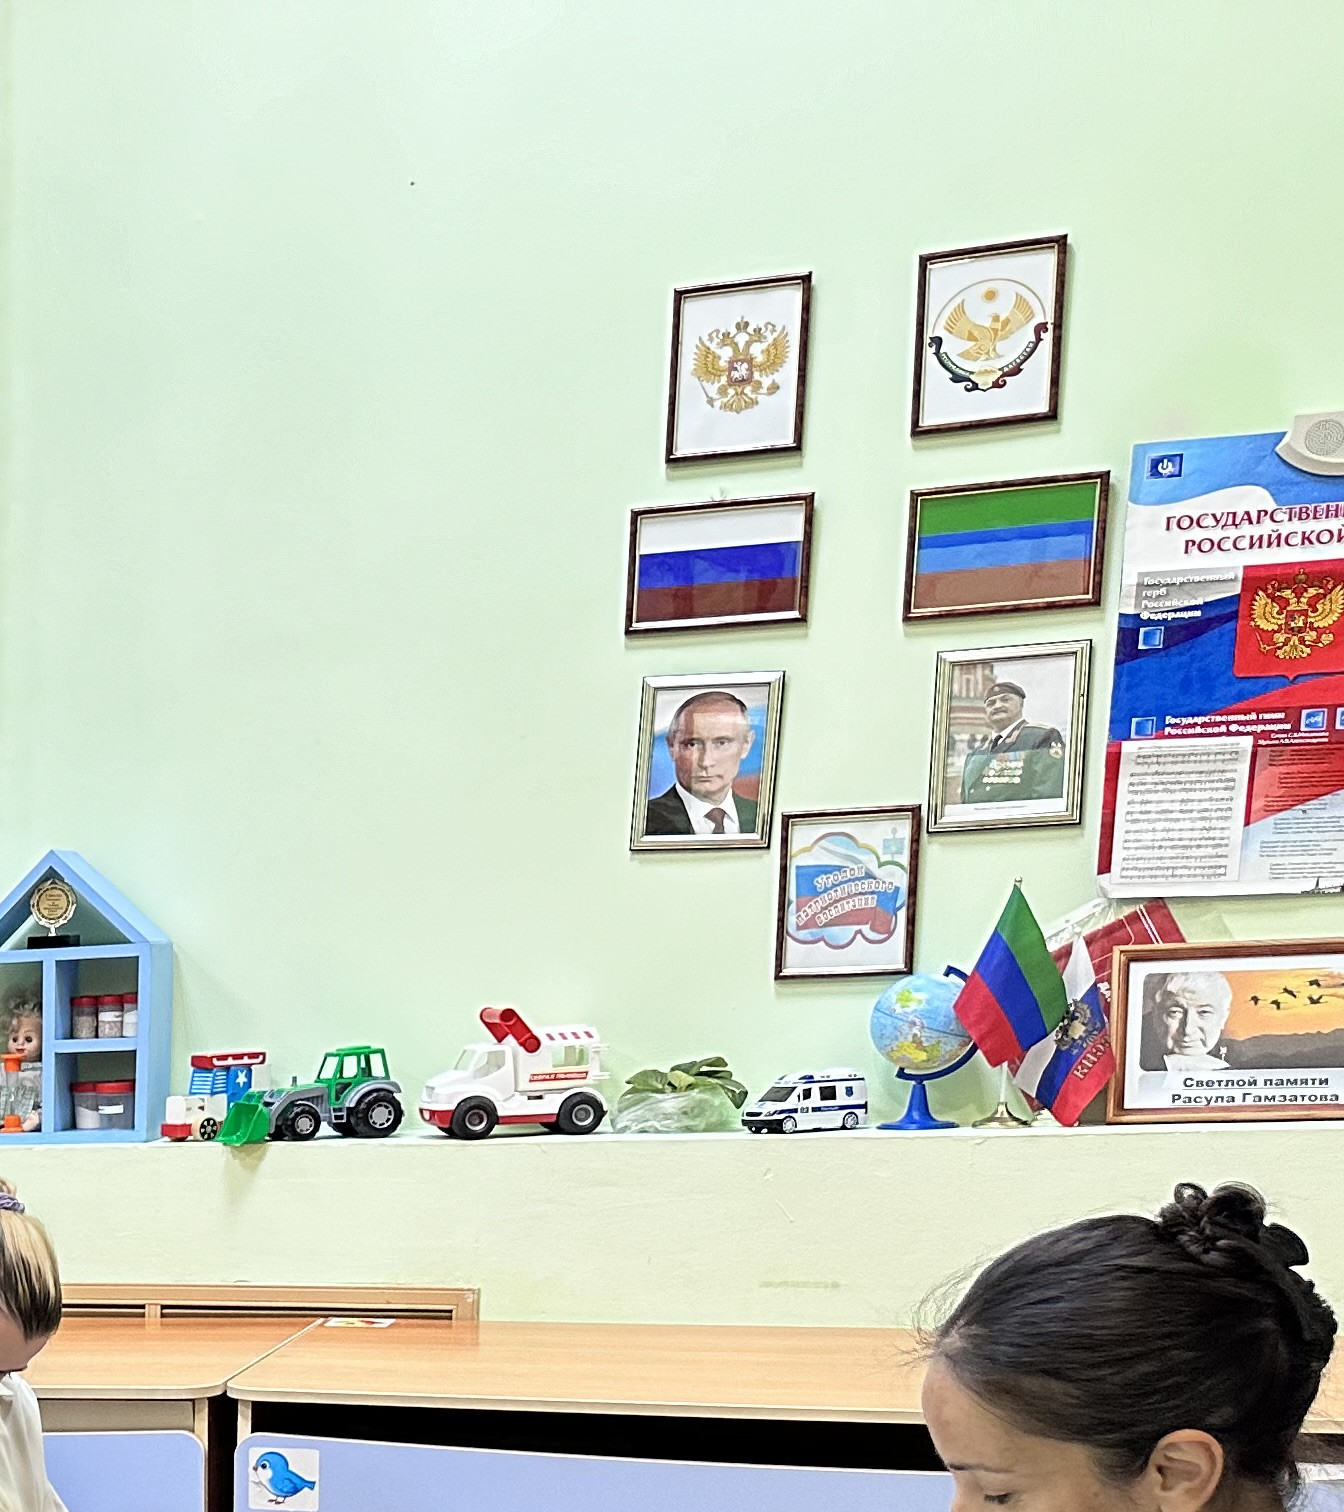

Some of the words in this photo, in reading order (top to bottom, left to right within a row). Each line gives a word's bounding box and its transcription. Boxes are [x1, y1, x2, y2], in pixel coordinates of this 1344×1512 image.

[1165, 503, 1344, 532] ГОСУДАРСТВЕН
[1143, 572, 1236, 586] Государственный
[1142, 588, 1167, 598] герб
[1141, 598, 1204, 608] Российской
[1140, 609, 1202, 621] Федерации
[1165, 711, 1258, 725] Государственный
[1164, 723, 1227, 736] Российской
[1229, 722, 1292, 735] Федерации
[796, 880, 894, 925] патриотического
[816, 896, 877, 925] воспитания
[1183, 1076, 1258, 1088] Светлой
[1263, 1077, 1330, 1088] памяти
[1171, 1092, 1236, 1106] Расула
[1241, 1092, 1340, 1104] Гамзатова
